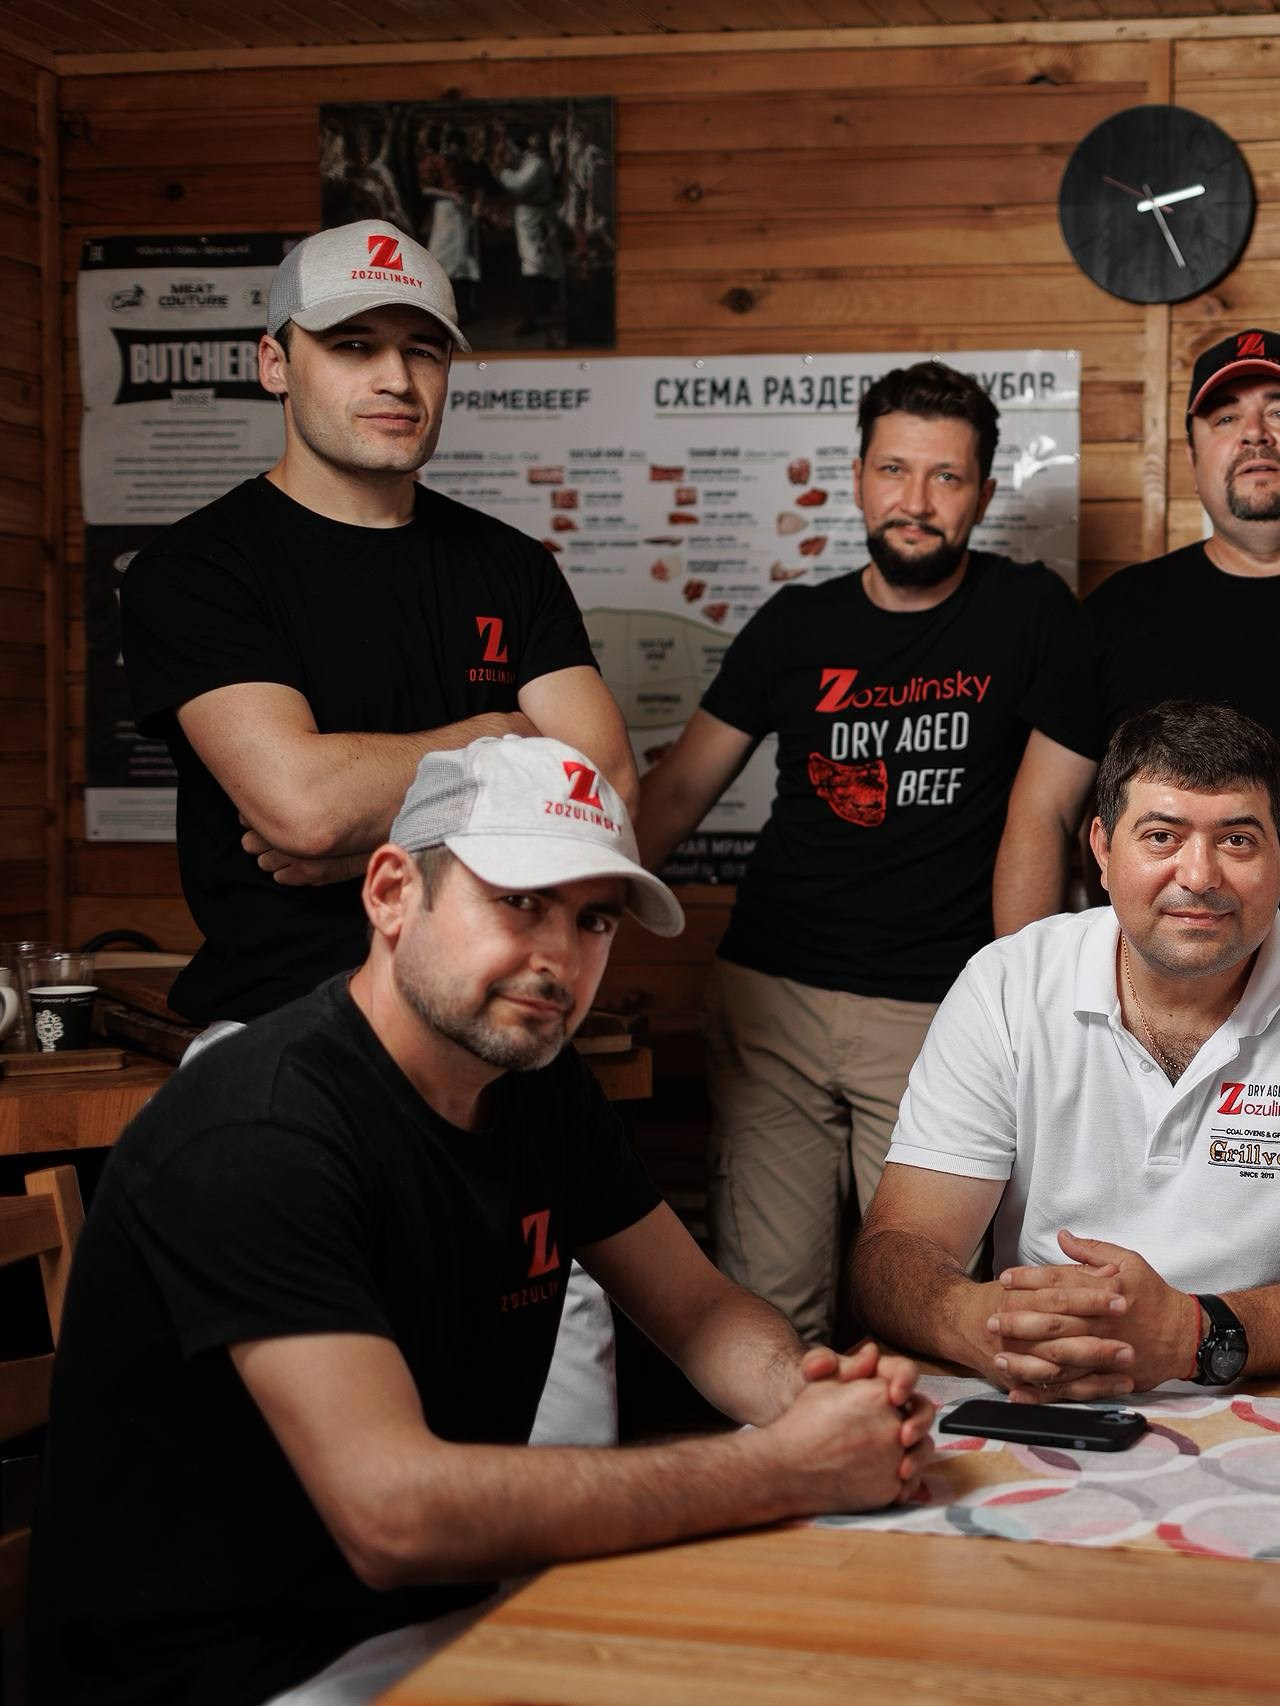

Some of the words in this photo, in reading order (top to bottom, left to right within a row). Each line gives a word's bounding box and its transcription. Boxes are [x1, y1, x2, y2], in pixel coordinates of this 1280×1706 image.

[367, 234, 404, 271] Z
[170, 283, 215, 294] MEAT
[351, 270, 423, 288] ZOZULINSKY
[159, 295, 229, 306] COUTURE
[1236, 332, 1265, 357] Z
[451, 388, 592, 411] PRIMEBEEF
[654, 377, 753, 408] СХЕМА
[967, 371, 1057, 400] УБОВ
[475, 616, 508, 664] Z
[464, 668, 516, 683] OZULIN
[815, 668, 992, 713] Zozulinsky
[831, 720, 889, 760] DRY
[895, 711, 969, 753] AGED
[561, 760, 604, 812] Z
[896, 767, 966, 807] BEEF
[1247, 1084, 1265, 1097] DRY
[1226, 1128, 1243, 1136] COAL
[1244, 1129, 1266, 1138] OVENS
[1266, 1131, 1272, 1139] &
[1239, 1170, 1259, 1179] SINCE
[521, 1209, 560, 1279] Z
